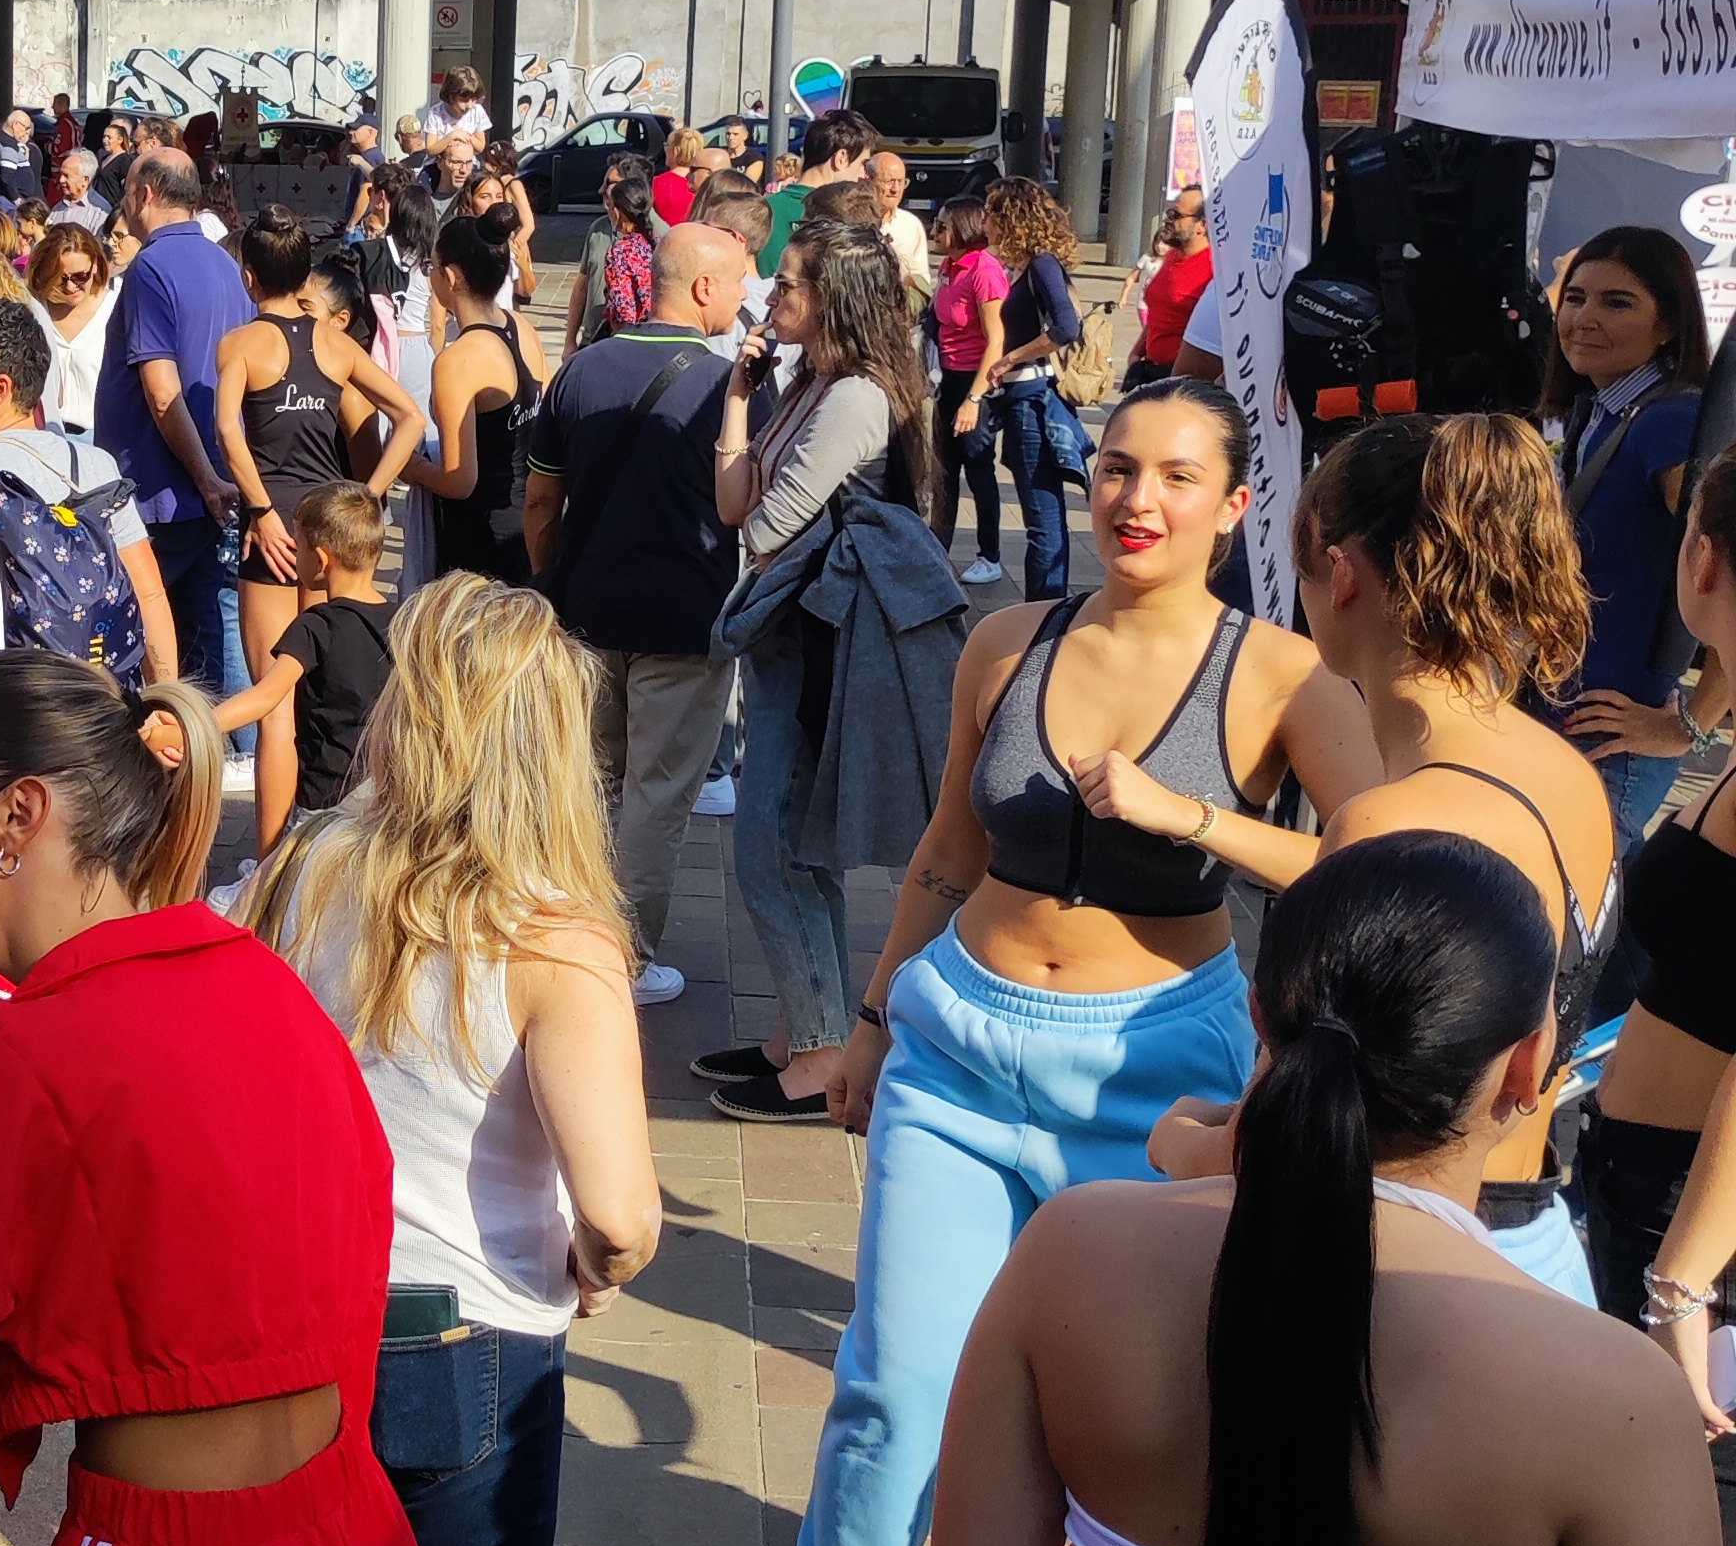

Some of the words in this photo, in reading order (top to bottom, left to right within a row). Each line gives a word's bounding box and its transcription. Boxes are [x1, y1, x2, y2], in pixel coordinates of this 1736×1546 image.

[1702, 195, 1736, 207] Ci
[1698, 224, 1736, 242] Pam
[275, 383, 326, 413] Lara
